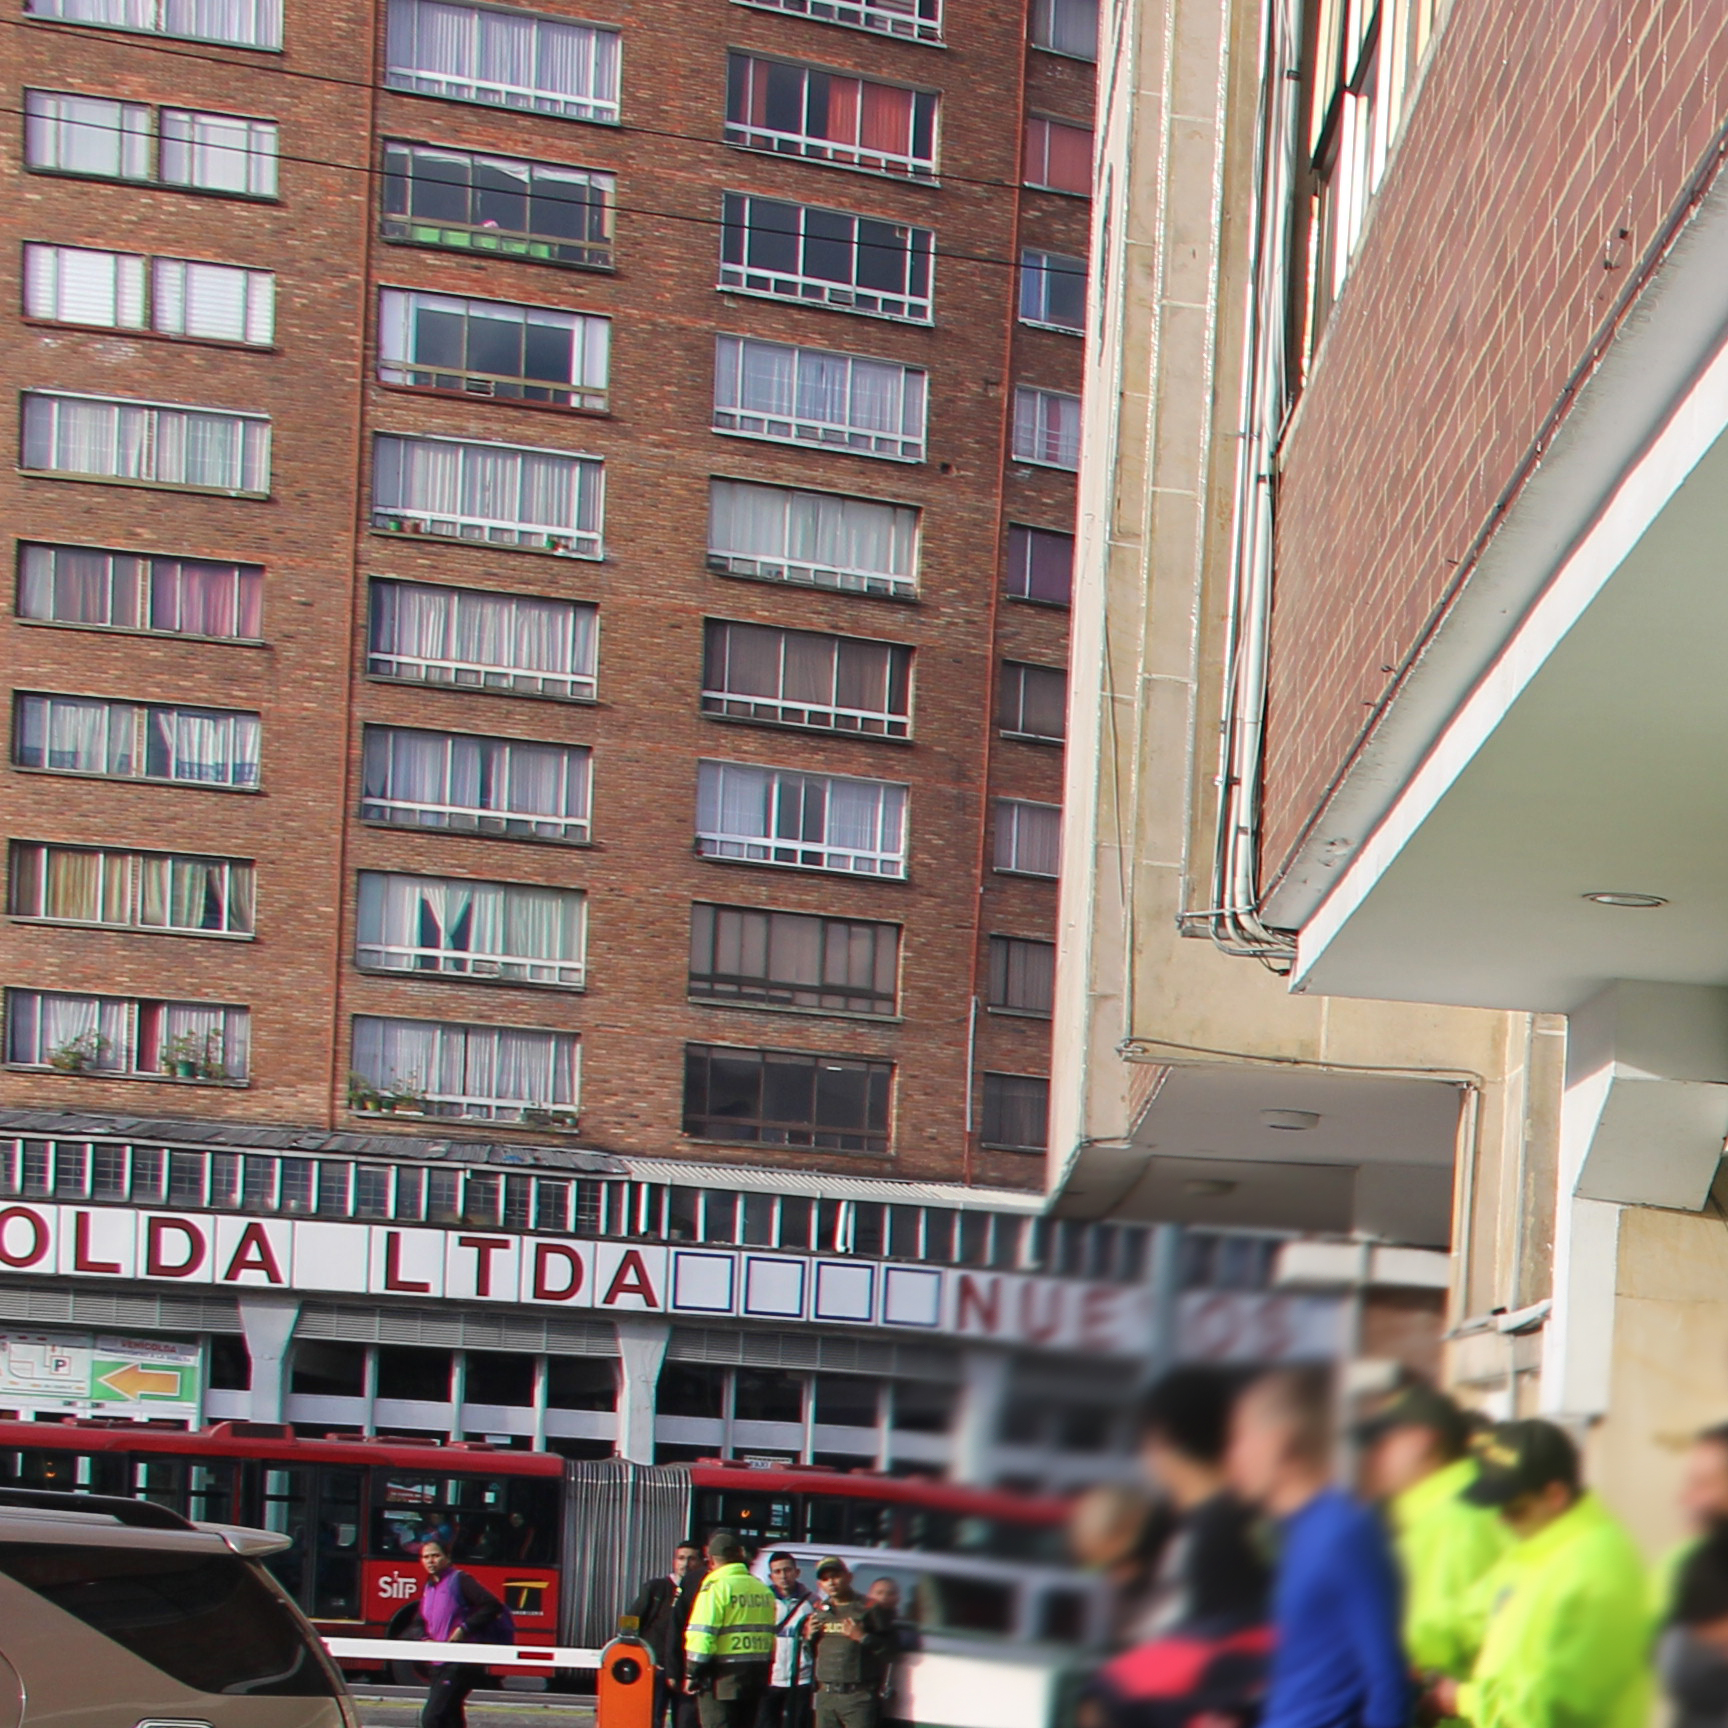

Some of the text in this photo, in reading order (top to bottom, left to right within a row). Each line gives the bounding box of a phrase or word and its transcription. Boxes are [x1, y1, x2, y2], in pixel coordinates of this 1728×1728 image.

[0, 1205, 661, 1309] OLDA LTDA
[956, 1273, 1298, 1361] NUEOS
